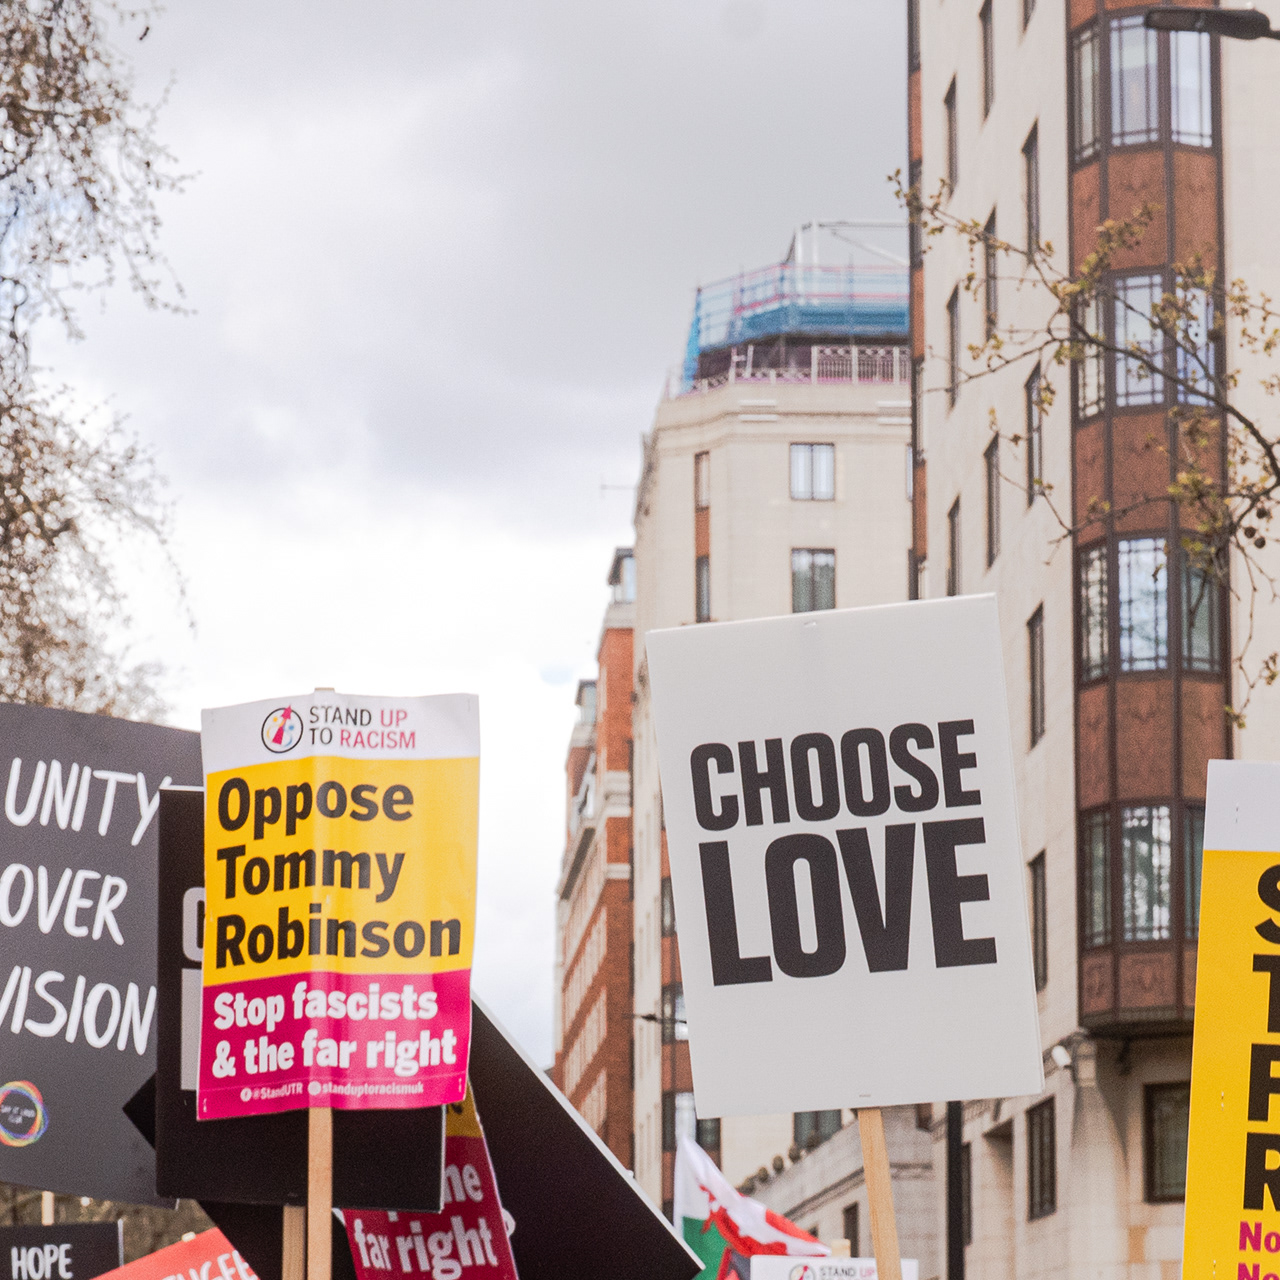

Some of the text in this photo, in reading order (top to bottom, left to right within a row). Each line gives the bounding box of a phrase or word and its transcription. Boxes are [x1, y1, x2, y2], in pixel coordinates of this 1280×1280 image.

[309, 705, 408, 729] STAND UP
[309, 727, 417, 750] TO RACISM
[5, 757, 173, 847] UNITY
[690, 719, 982, 832] CHOOSE
[218, 776, 415, 840] Oppose
[216, 843, 406, 903] Tommy
[698, 817, 998, 987] LOVE
[215, 902, 461, 969] Robinson
[213, 981, 439, 1033] Stop fascists
[212, 1028, 457, 1079] & the far right
[354, 1218, 392, 1271] far
[820, 1266, 857, 1278] STAND
